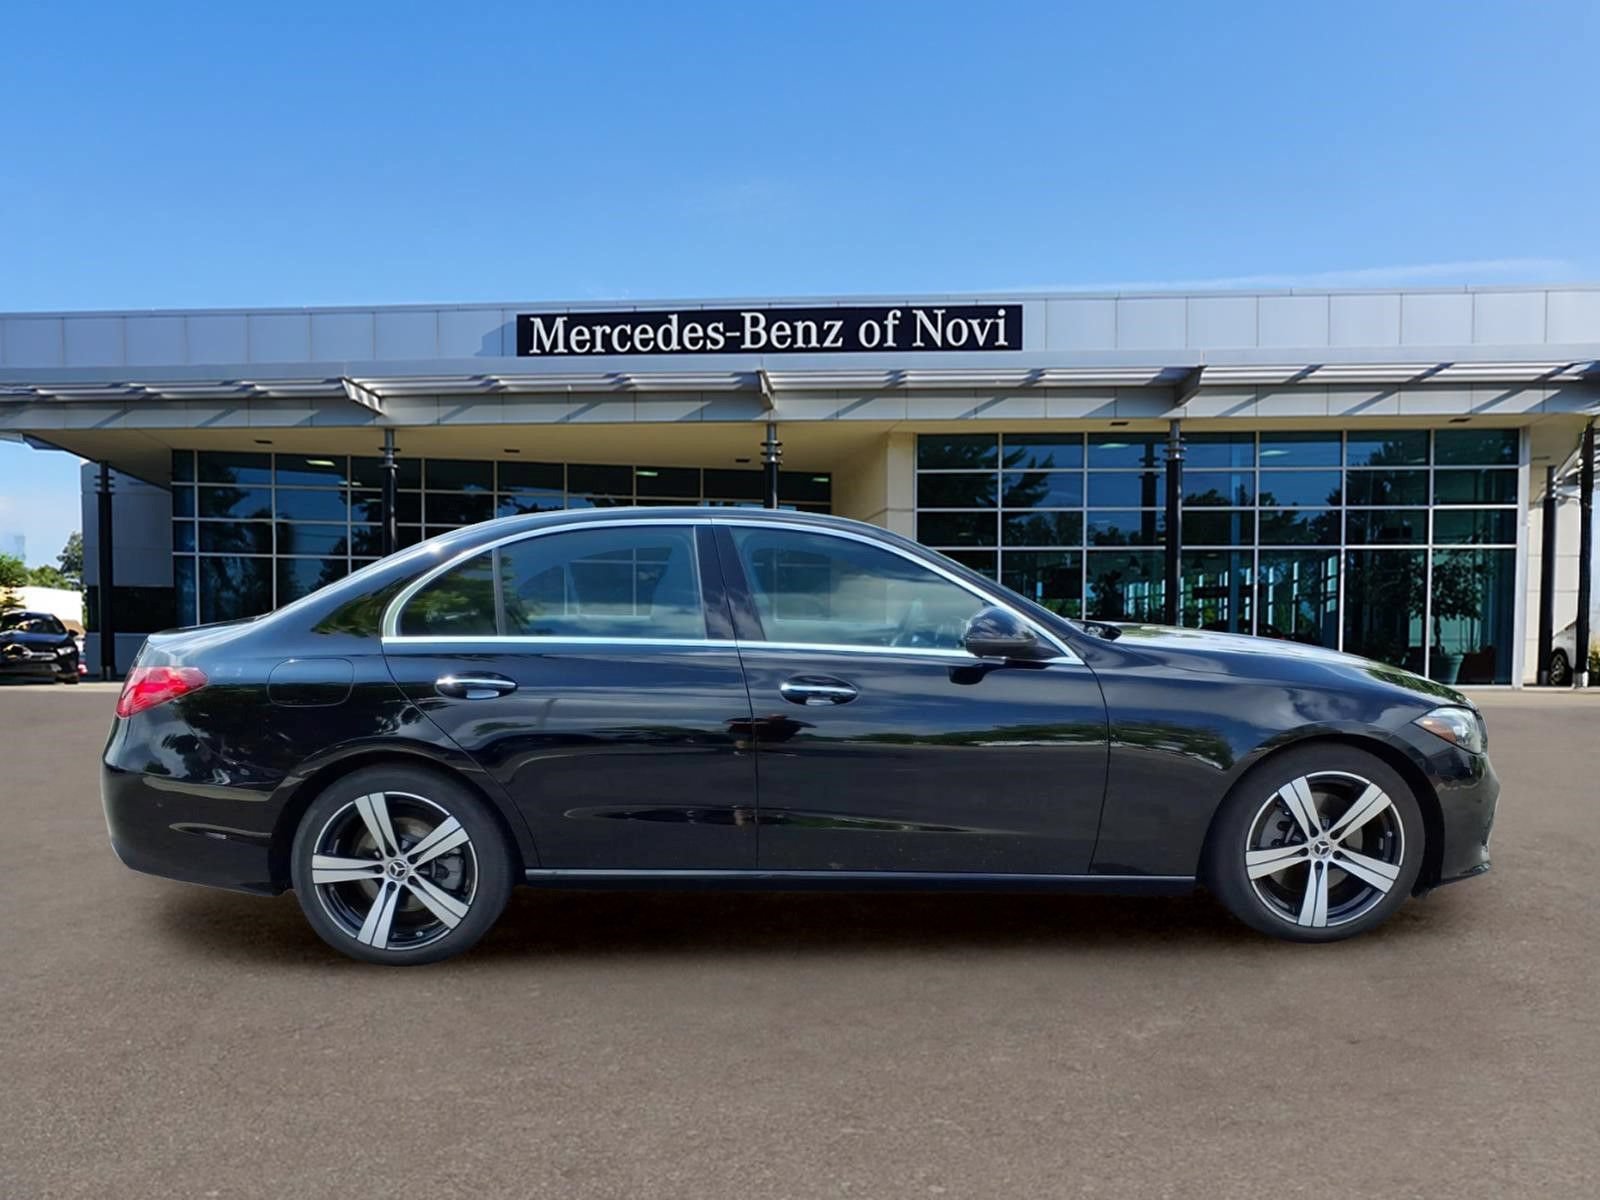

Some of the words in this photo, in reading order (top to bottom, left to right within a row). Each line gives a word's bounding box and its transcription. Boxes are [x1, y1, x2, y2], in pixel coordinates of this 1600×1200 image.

[529, 311, 843, 354] Mercedes-Benz
[858, 309, 901, 347] of
[911, 308, 1009, 347] Novi
